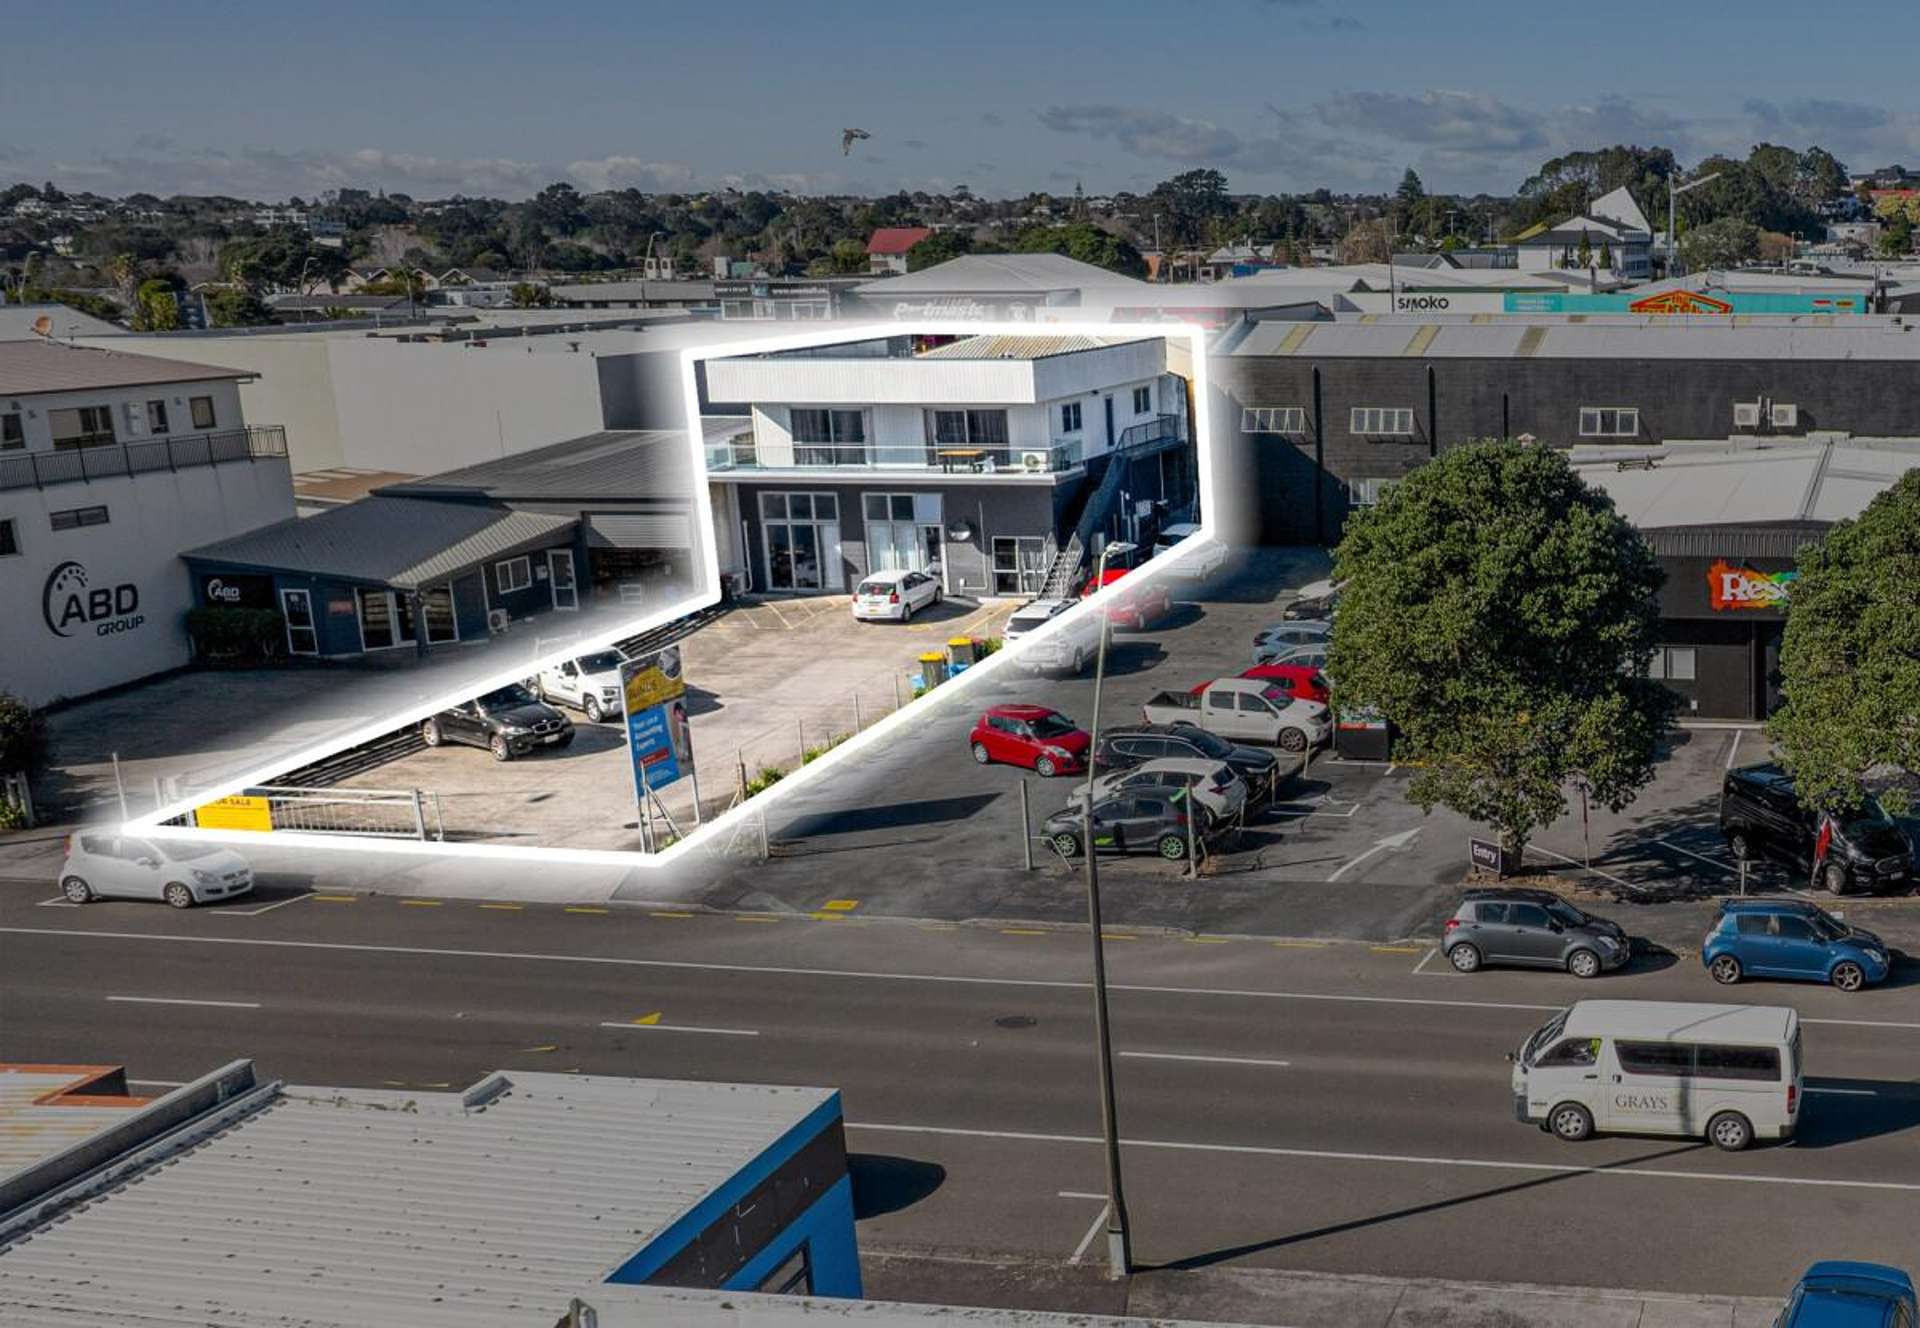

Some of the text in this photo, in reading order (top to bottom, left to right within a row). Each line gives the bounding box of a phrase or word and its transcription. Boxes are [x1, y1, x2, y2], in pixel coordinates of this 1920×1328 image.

[1397, 296, 1449, 312] SMOKO
[60, 583, 139, 628] ABD
[96, 615, 145, 637] GROUP
[1473, 844, 1497, 864] Entry
[1615, 1094, 1668, 1110] GRAYS
